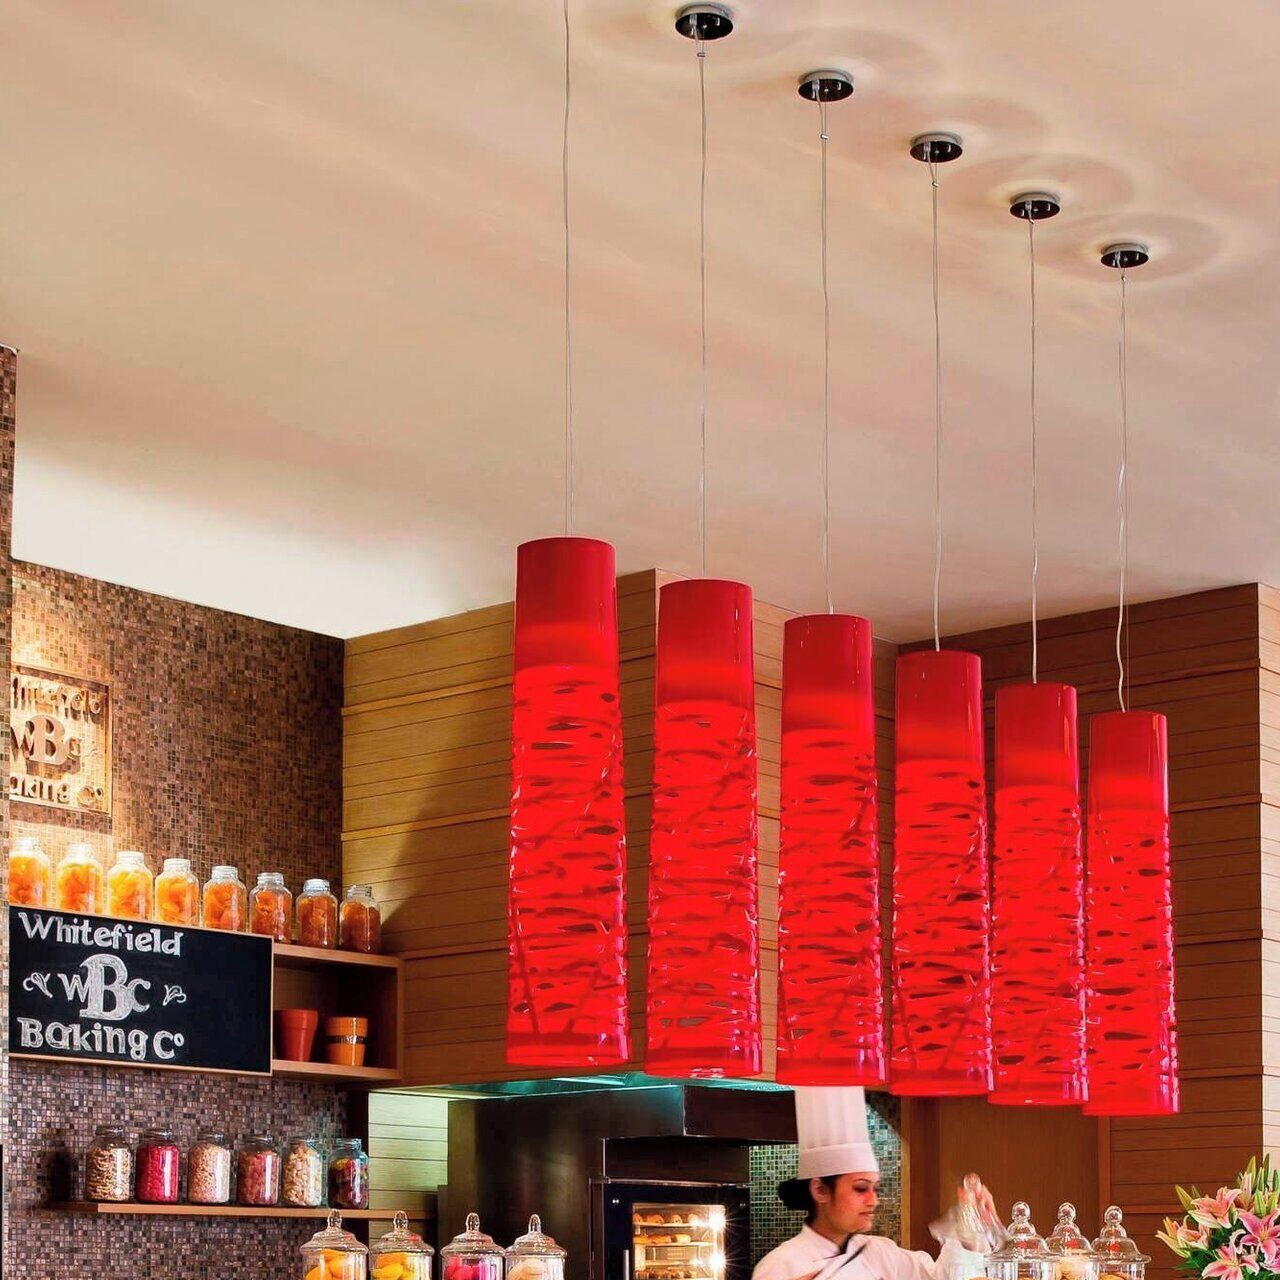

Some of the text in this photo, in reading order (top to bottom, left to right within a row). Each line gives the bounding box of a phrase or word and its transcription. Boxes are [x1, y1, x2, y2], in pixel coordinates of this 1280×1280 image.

[18, 912, 184, 956] Whitefield
[58, 954, 151, 1021] WBC
[18, 1017, 149, 1061] Baking
